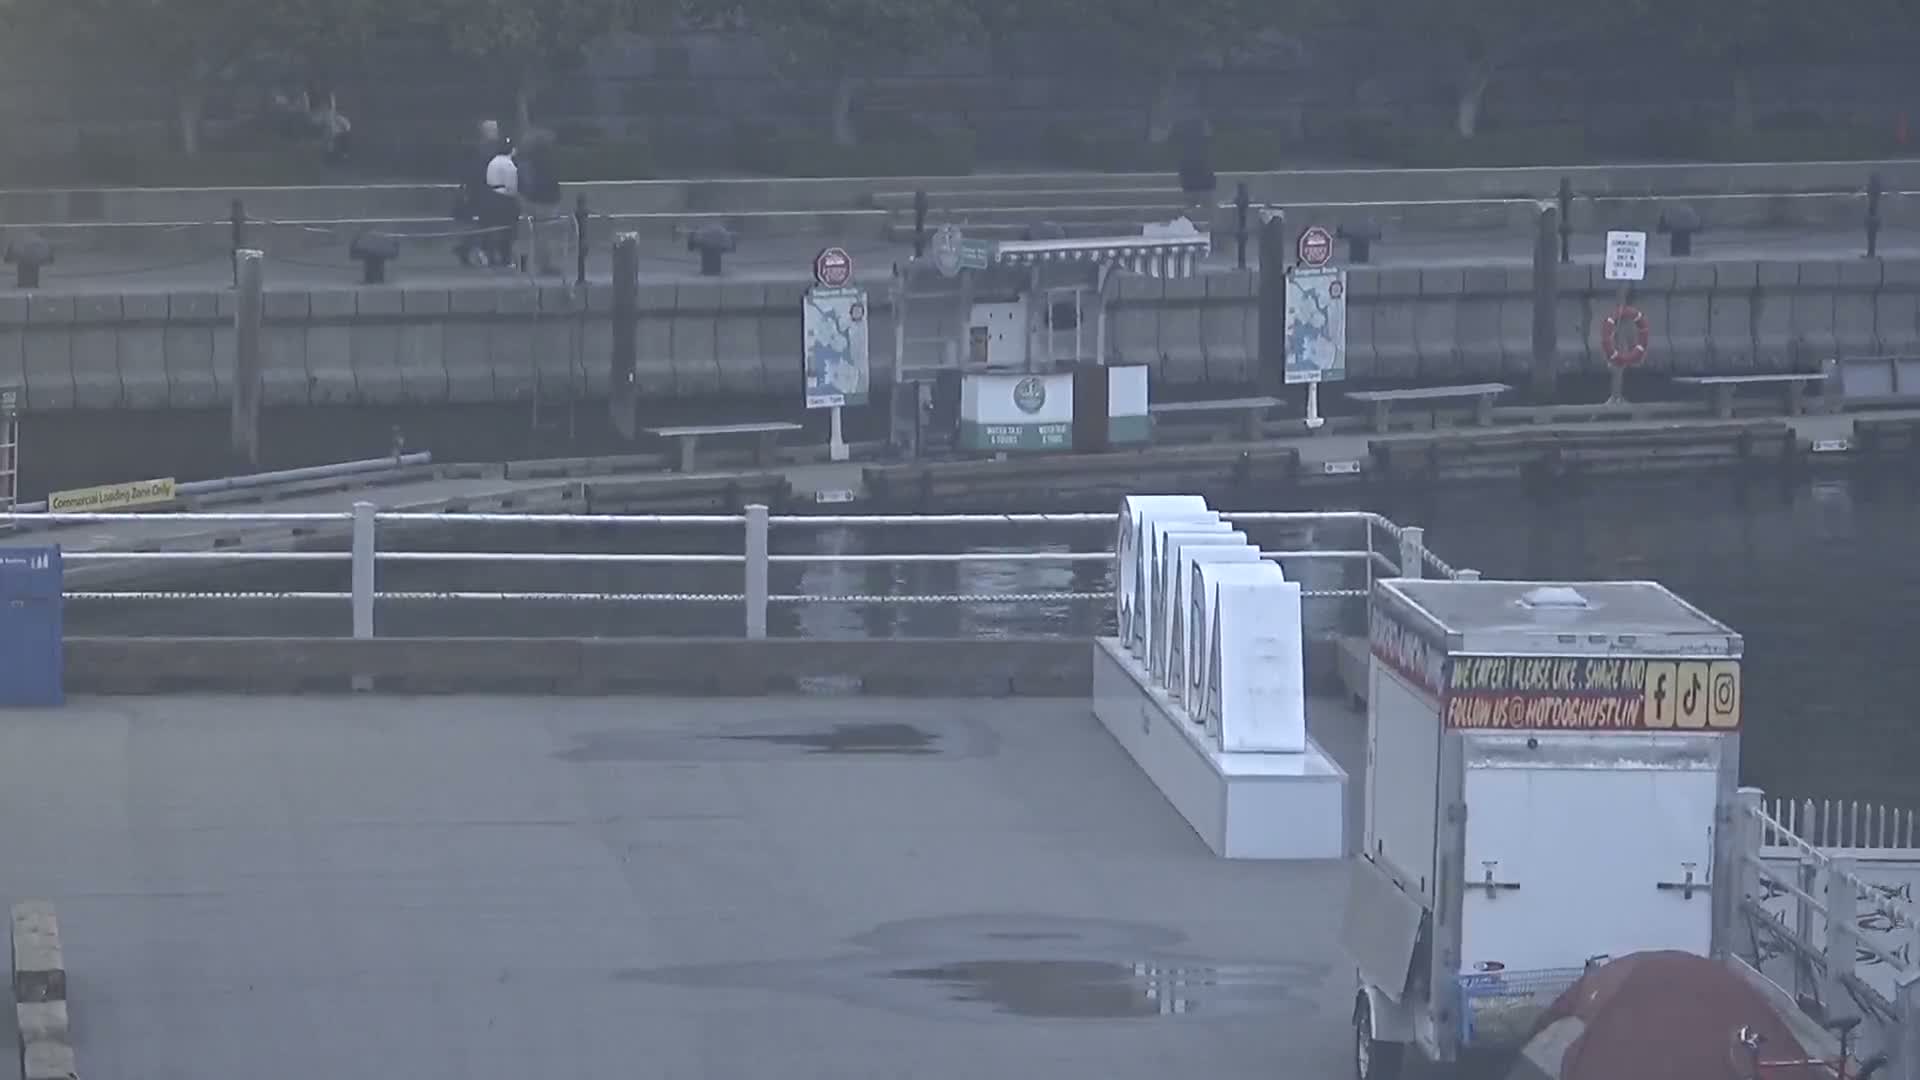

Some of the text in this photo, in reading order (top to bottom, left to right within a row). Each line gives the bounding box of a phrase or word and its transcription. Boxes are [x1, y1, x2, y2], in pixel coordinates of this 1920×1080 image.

[53, 482, 172, 509] Commercial Loading Zone Only
[1117, 495, 1224, 752] CANADA
[1450, 658, 1472, 690] WE
[1512, 658, 1551, 691] PLEASE
[1585, 658, 1620, 691] SHARE
[1621, 658, 1645, 690] AND
[1448, 697, 1492, 728] FOLLOW
